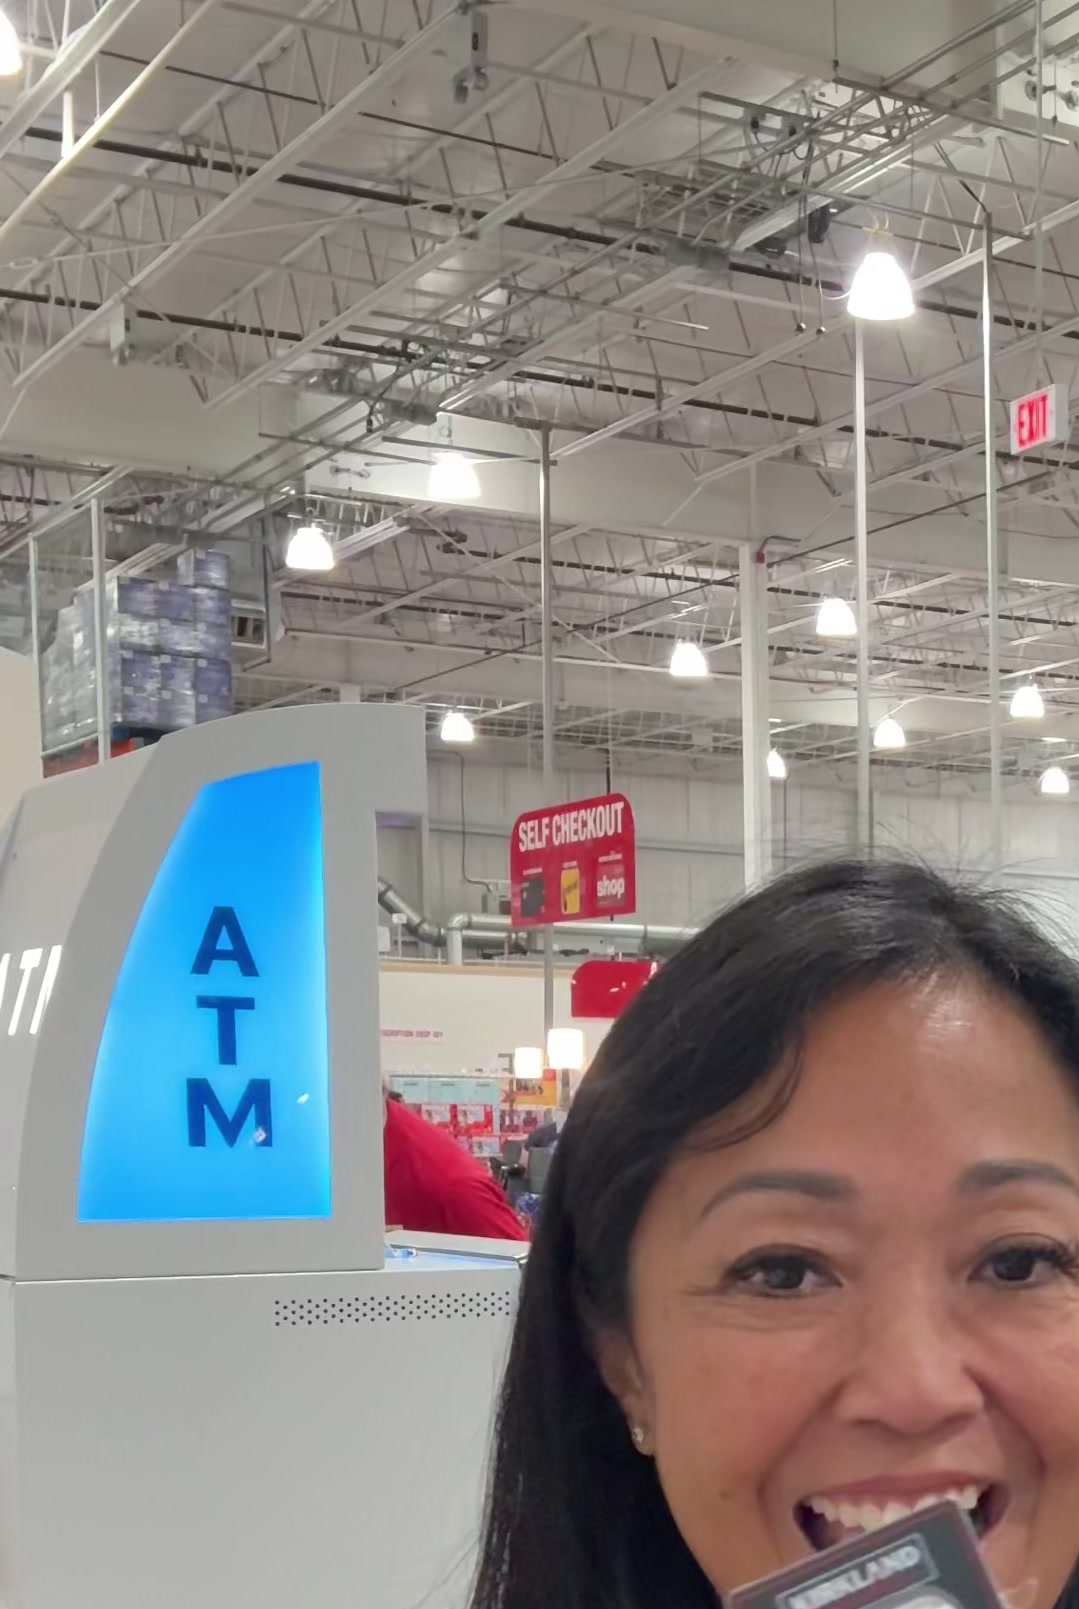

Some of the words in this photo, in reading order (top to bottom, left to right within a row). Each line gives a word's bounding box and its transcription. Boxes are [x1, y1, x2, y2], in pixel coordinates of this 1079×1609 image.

[1019, 394, 1048, 449] EXIT
[518, 817, 550, 852] SELF
[552, 801, 625, 847] CHECKOUT
[186, 905, 273, 1148] ATM
